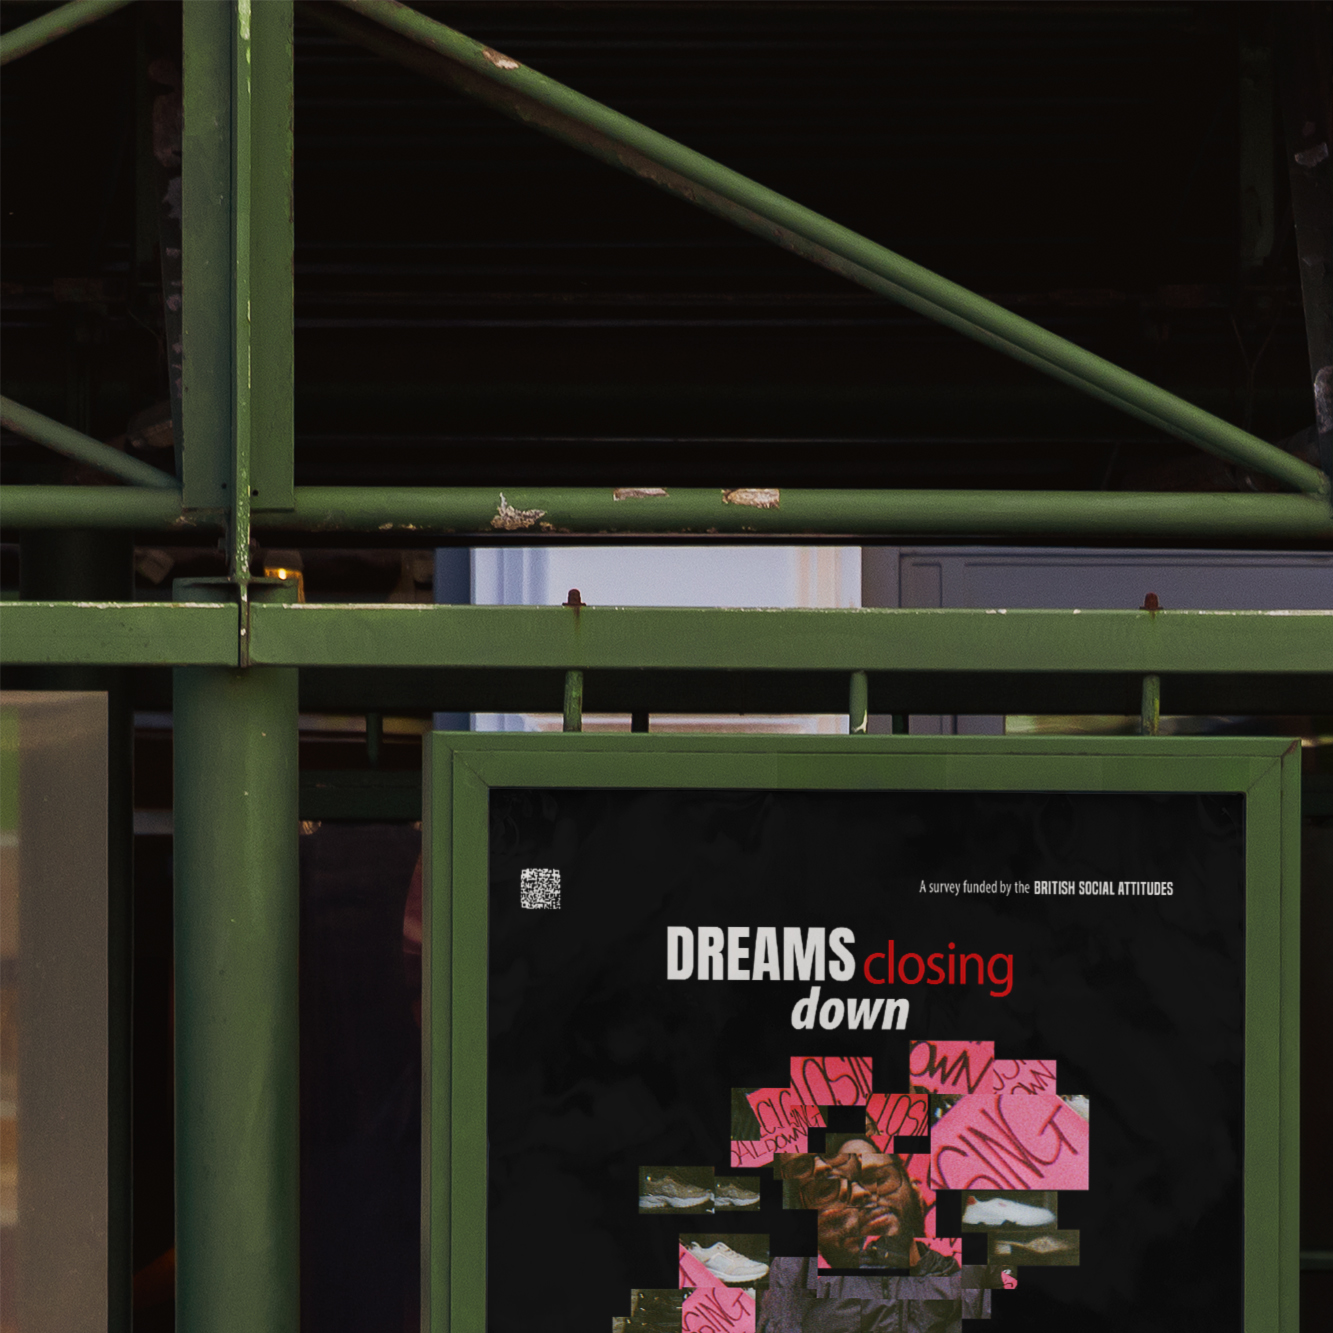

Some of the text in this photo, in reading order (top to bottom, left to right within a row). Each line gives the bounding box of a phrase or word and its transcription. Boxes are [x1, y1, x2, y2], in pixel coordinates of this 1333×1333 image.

[918, 879, 1174, 897] A survey funded by the BRITISH SOCIAL ATTITUDES
[666, 925, 1014, 998] DREAMS closing
[790, 985, 910, 1031] down
